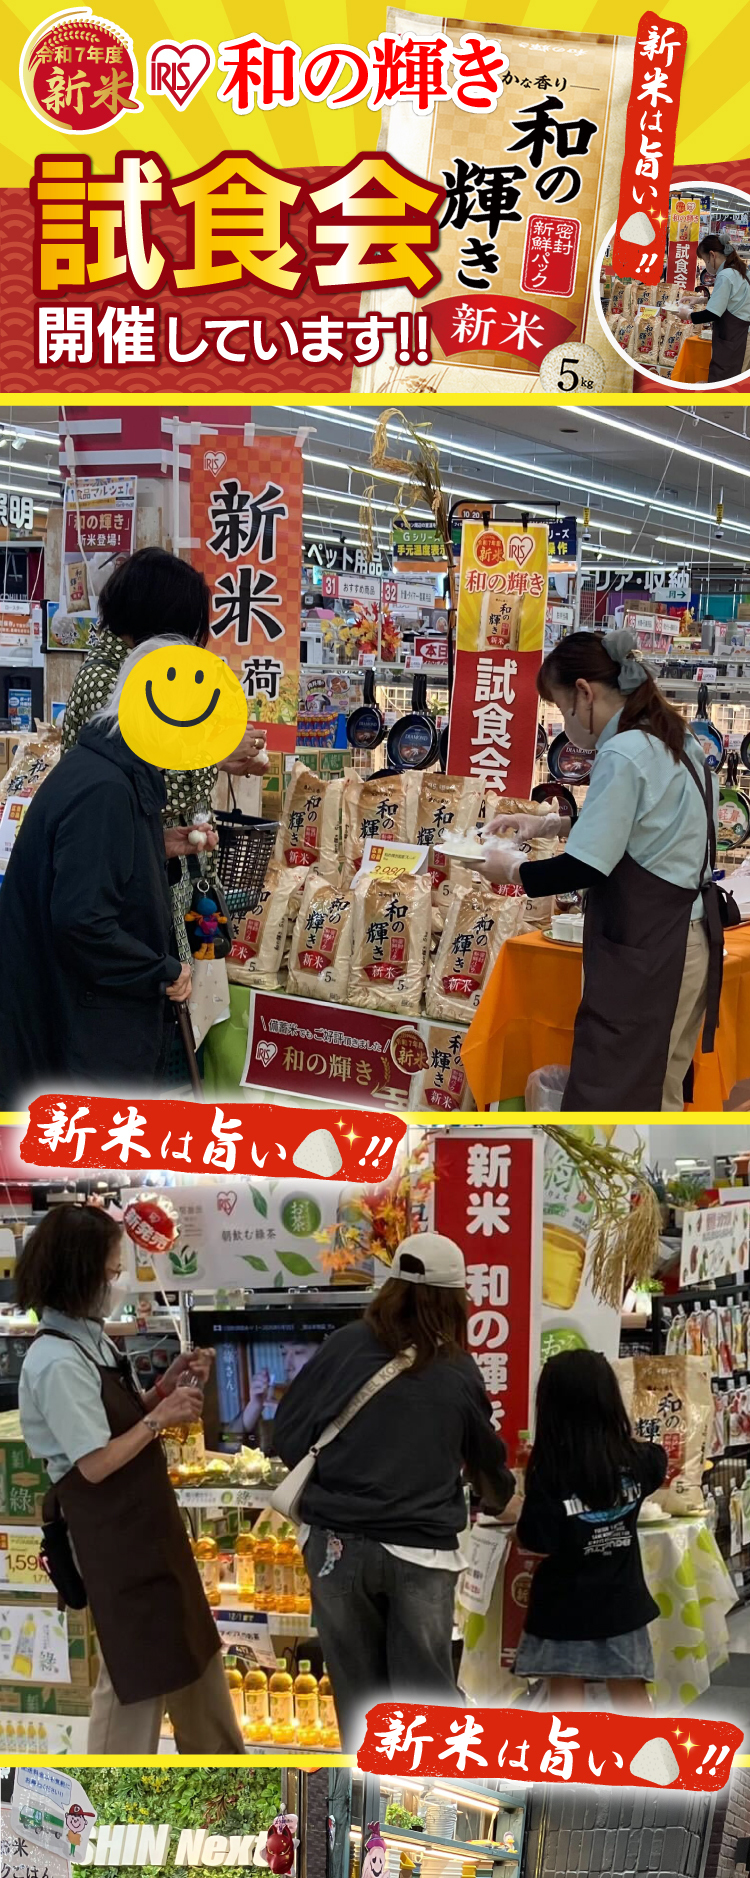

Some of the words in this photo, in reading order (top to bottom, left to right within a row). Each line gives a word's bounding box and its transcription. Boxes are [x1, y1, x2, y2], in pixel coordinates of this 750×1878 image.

[209, 480, 286, 642] 新米
[307, 544, 383, 575] ペット用品
[397, 544, 446, 556] 手元温度表示
[479, 547, 505, 562] 新米
[325, 577, 336, 594] 31
[385, 586, 396, 600] 32
[466, 570, 545, 596] 和の輝き
[469, 658, 518, 793] 試食会
[377, 799, 398, 829] 和の
[289, 851, 310, 865] 新米
[328, 898, 350, 924] 和の
[385, 899, 409, 933] 和の
[305, 911, 328, 949] 輝き
[366, 922, 389, 961] 輝き
[473, 914, 495, 947] 和の
[302, 953, 325, 968] 新米
[452, 933, 474, 973] 輝き
[371, 965, 397, 979] 新米
[448, 978, 473, 993] 新米
[268, 1019, 382, 1053] 備蓄米でもご好評頂きました
[282, 1045, 373, 1086] 和の輝き
[398, 1049, 429, 1069] 新米
[431, 1050, 451, 1088] 輝き
[430, 1092, 452, 1109] 新米
[466, 1144, 511, 1237] 新米
[126, 1210, 173, 1251] 新発売
[658, 1393, 682, 1429] 和の
